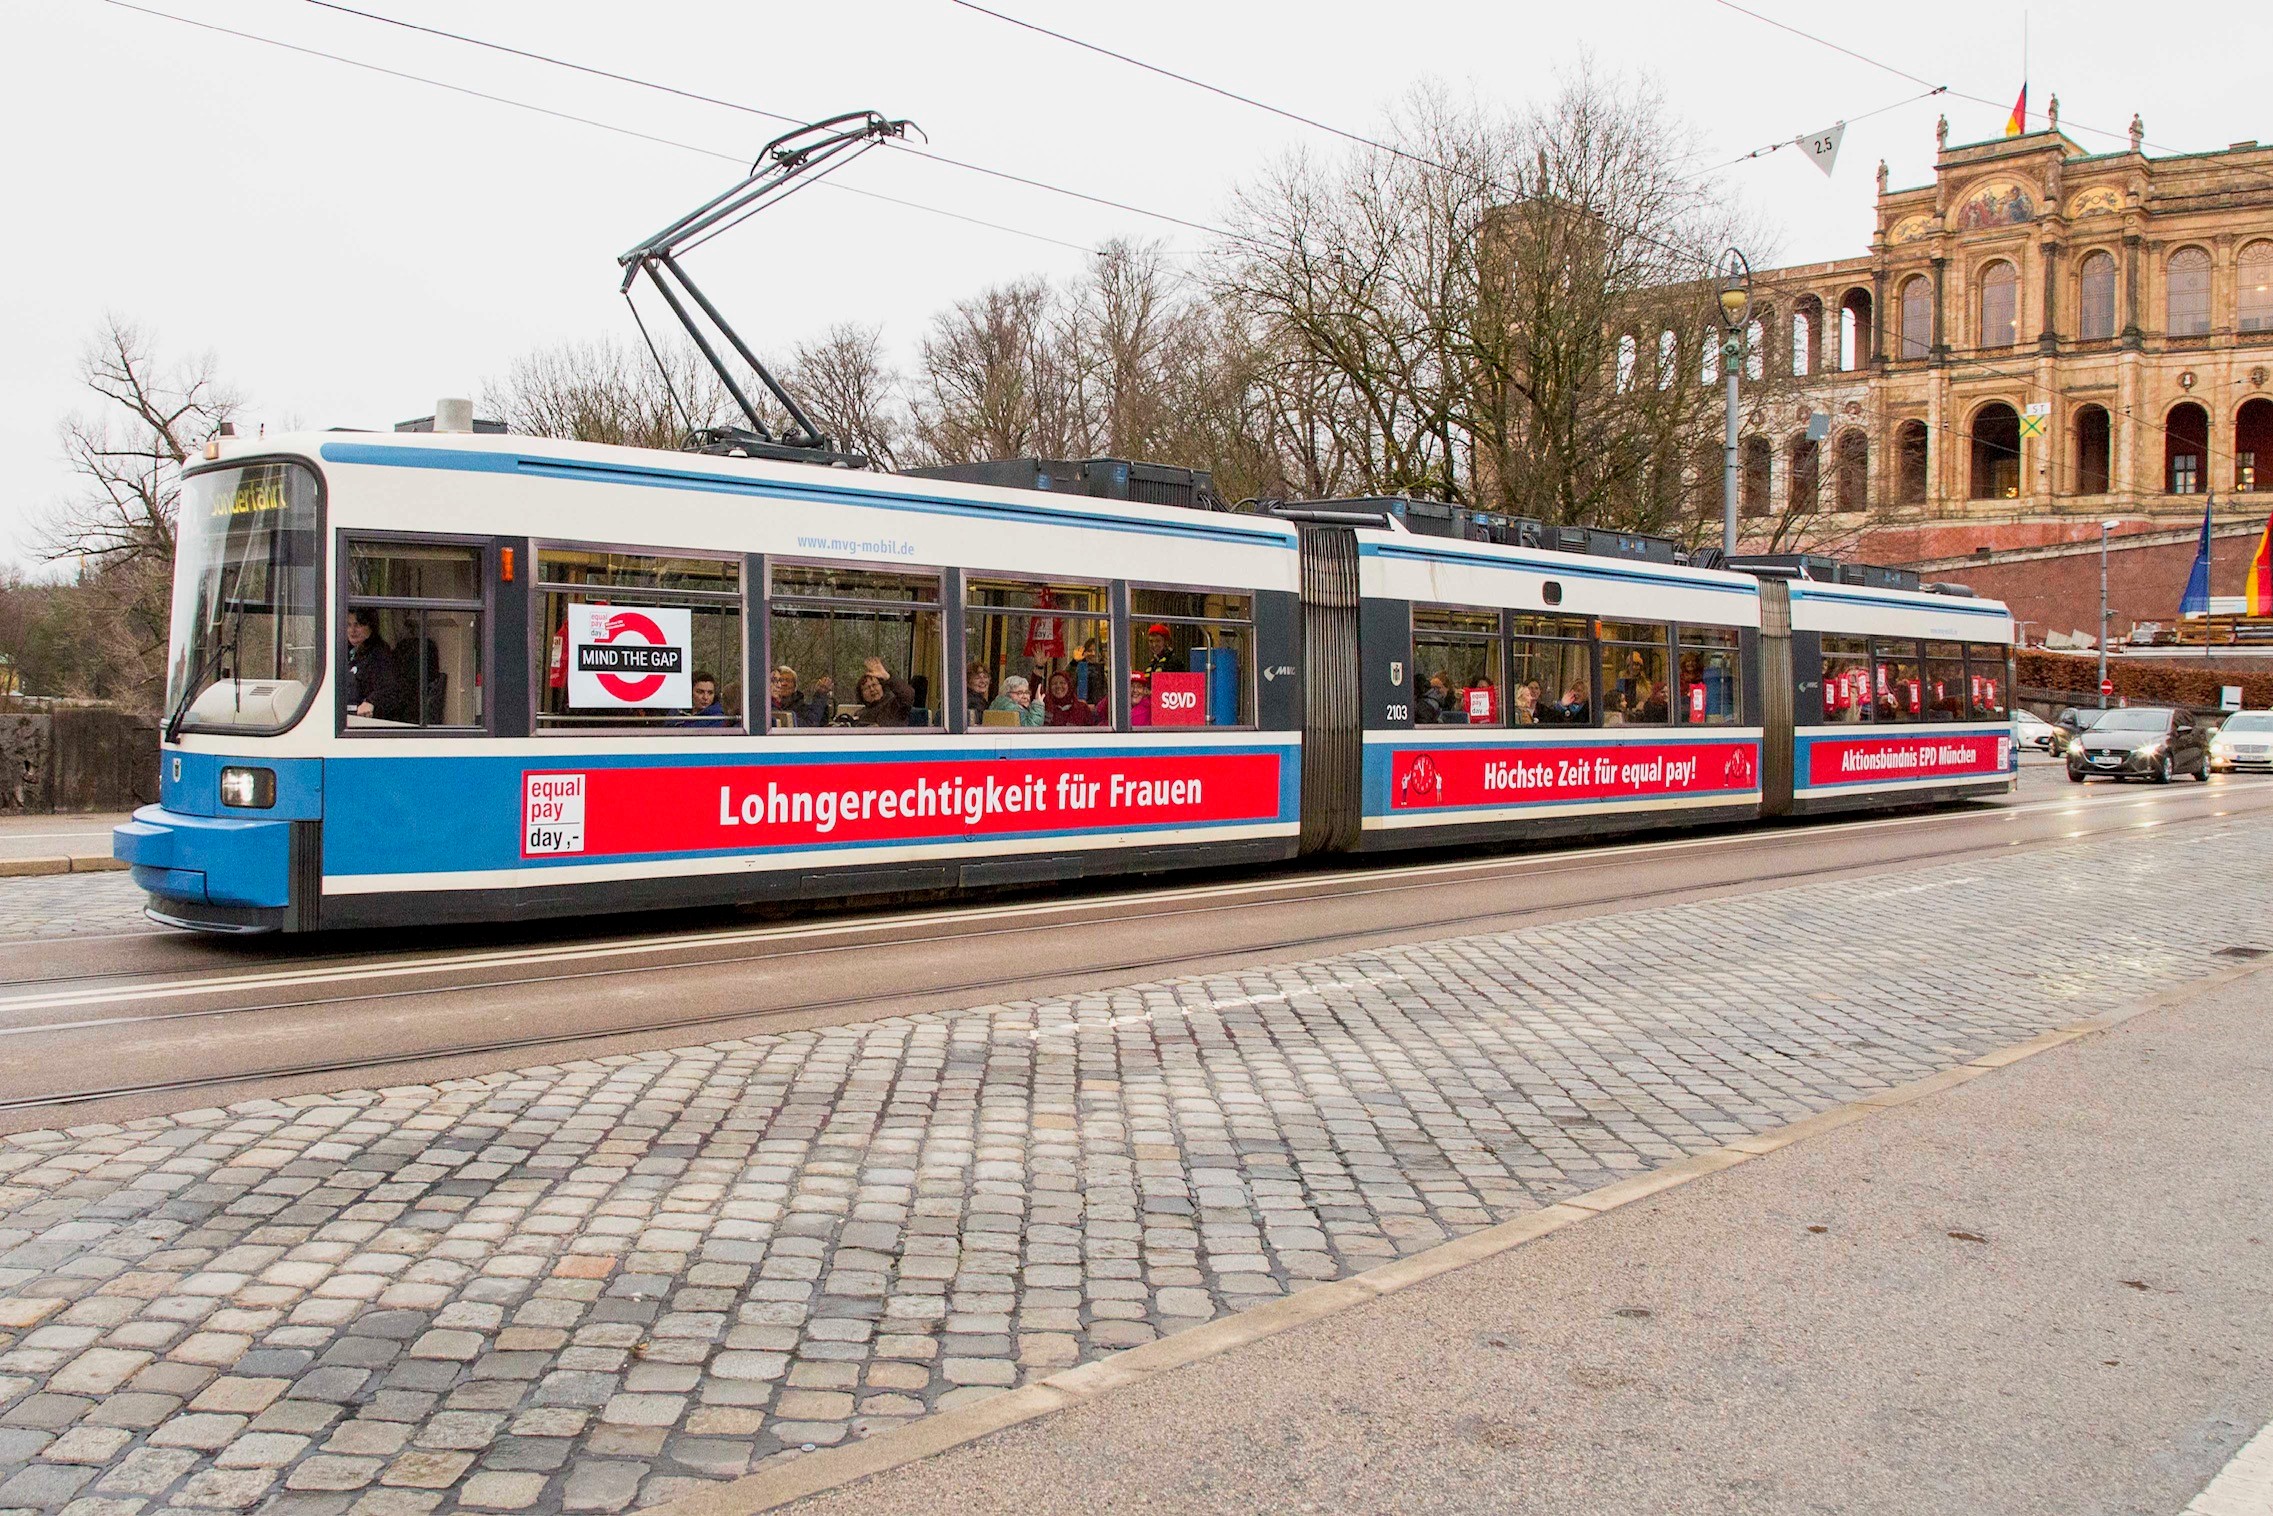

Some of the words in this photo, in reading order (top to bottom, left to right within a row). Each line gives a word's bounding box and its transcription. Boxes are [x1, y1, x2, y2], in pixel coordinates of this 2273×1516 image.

[1814, 136, 1833, 154] 2.5
[797, 536, 915, 555] www.mvg-mobil.de
[582, 649, 618, 667] MIND
[621, 650, 648, 667] THE
[650, 651, 679, 668] GAP
[1386, 704, 1408, 721] 2103
[1841, 745, 1918, 772] Aktionsbündnis
[1919, 746, 1937, 767] EPD
[1938, 744, 1977, 766] München
[1484, 758, 1553, 790] Höchste
[1557, 758, 1590, 787] Zeit
[1594, 757, 1618, 785] für
[1621, 755, 1662, 790] equal
[1665, 755, 1697, 788] pay!
[531, 777, 581, 801] equal
[531, 802, 564, 822] pay
[719, 773, 1046, 834] Lohngerechtigkeit
[1056, 772, 1100, 811] für
[1109, 773, 1202, 809] Frauen
